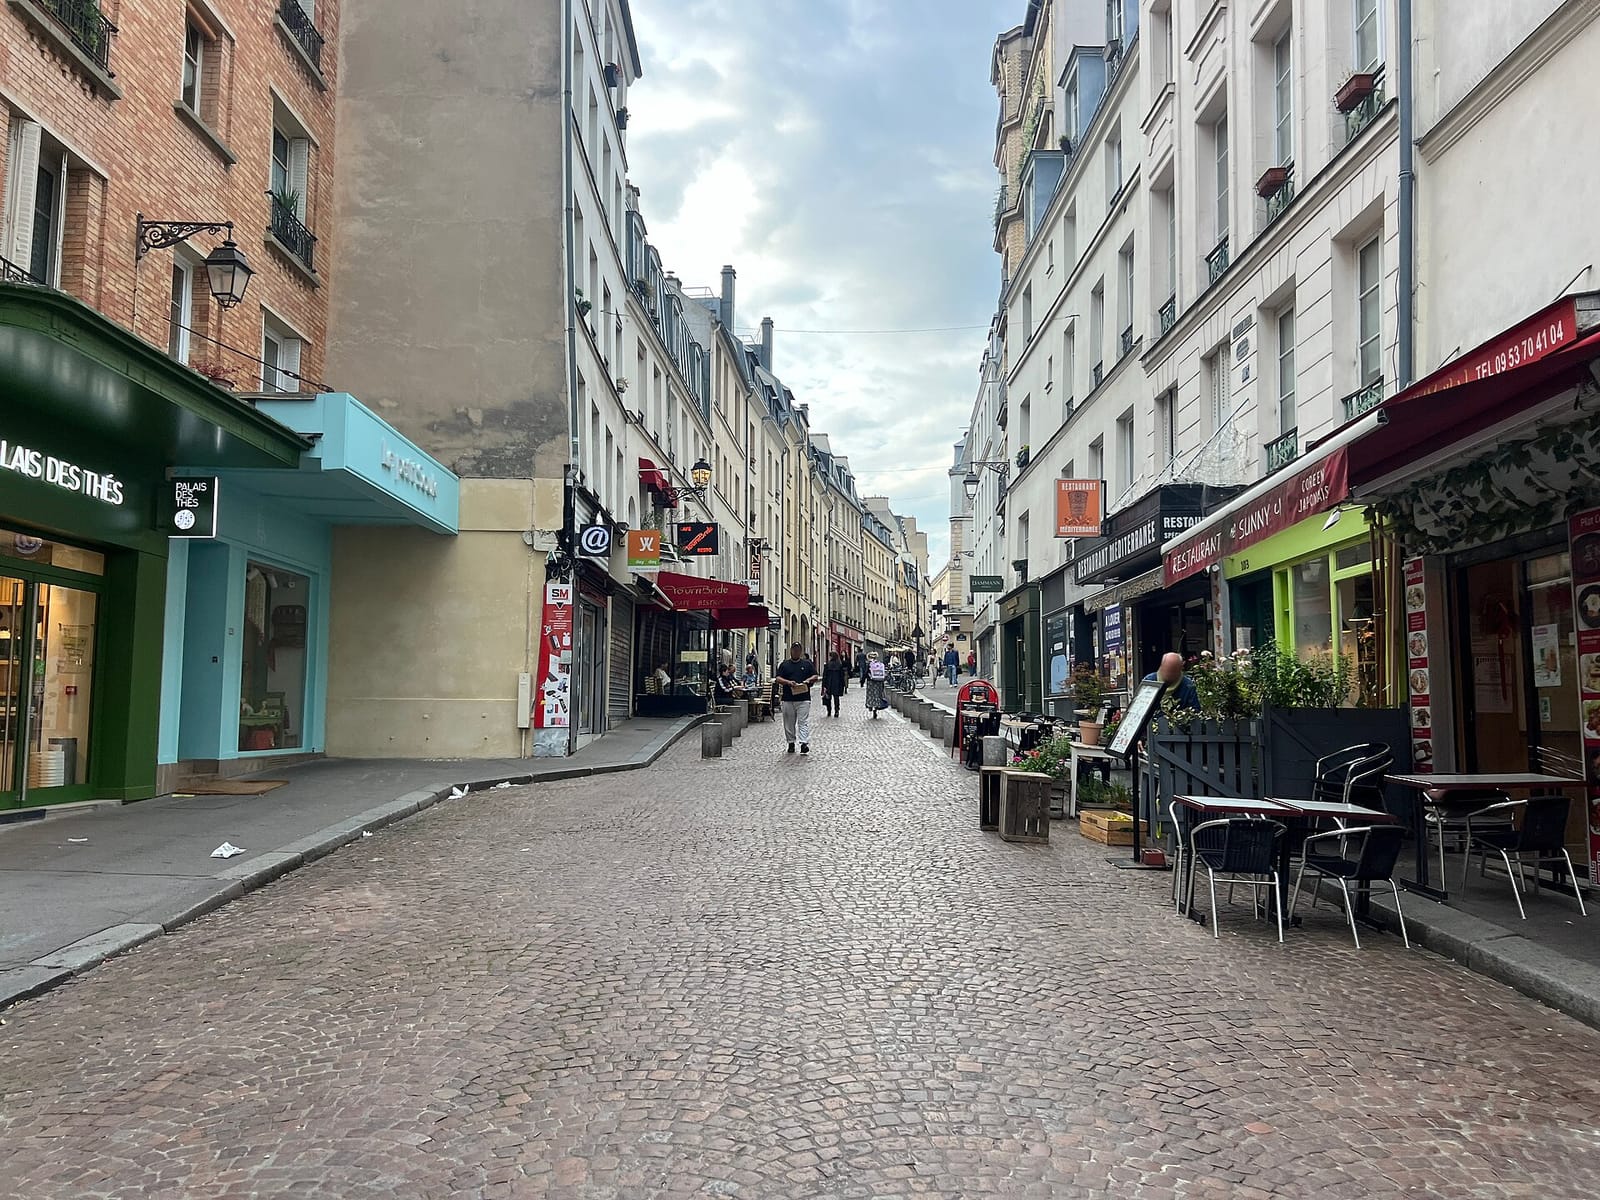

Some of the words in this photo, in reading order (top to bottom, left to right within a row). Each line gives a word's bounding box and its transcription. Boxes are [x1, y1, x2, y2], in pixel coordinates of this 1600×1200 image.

[1495, 354, 1507, 374] 09
[1508, 345, 1521, 368] 53
[1521, 336, 1534, 361] 70
[1535, 328, 1548, 352] 41
[1549, 320, 1564, 345] 04
[45, 456, 81, 491] DES
[82, 469, 124, 506] THÉS
[175, 482, 208, 491] PALAIS
[175, 490, 194, 499] DES
[1061, 482, 1096, 491] RESTAURANT
[1298, 485, 1329, 513] JAPONAIS
[1163, 516, 1207, 529] RESTAU
[1238, 503, 1271, 540] SUNNY
[1077, 547, 1108, 579] RESTAURANT
[1109, 520, 1156, 564] MÉDITERRANÉE
[1172, 533, 1222, 575] RESTAURANT
[551, 588, 569, 598] SM
